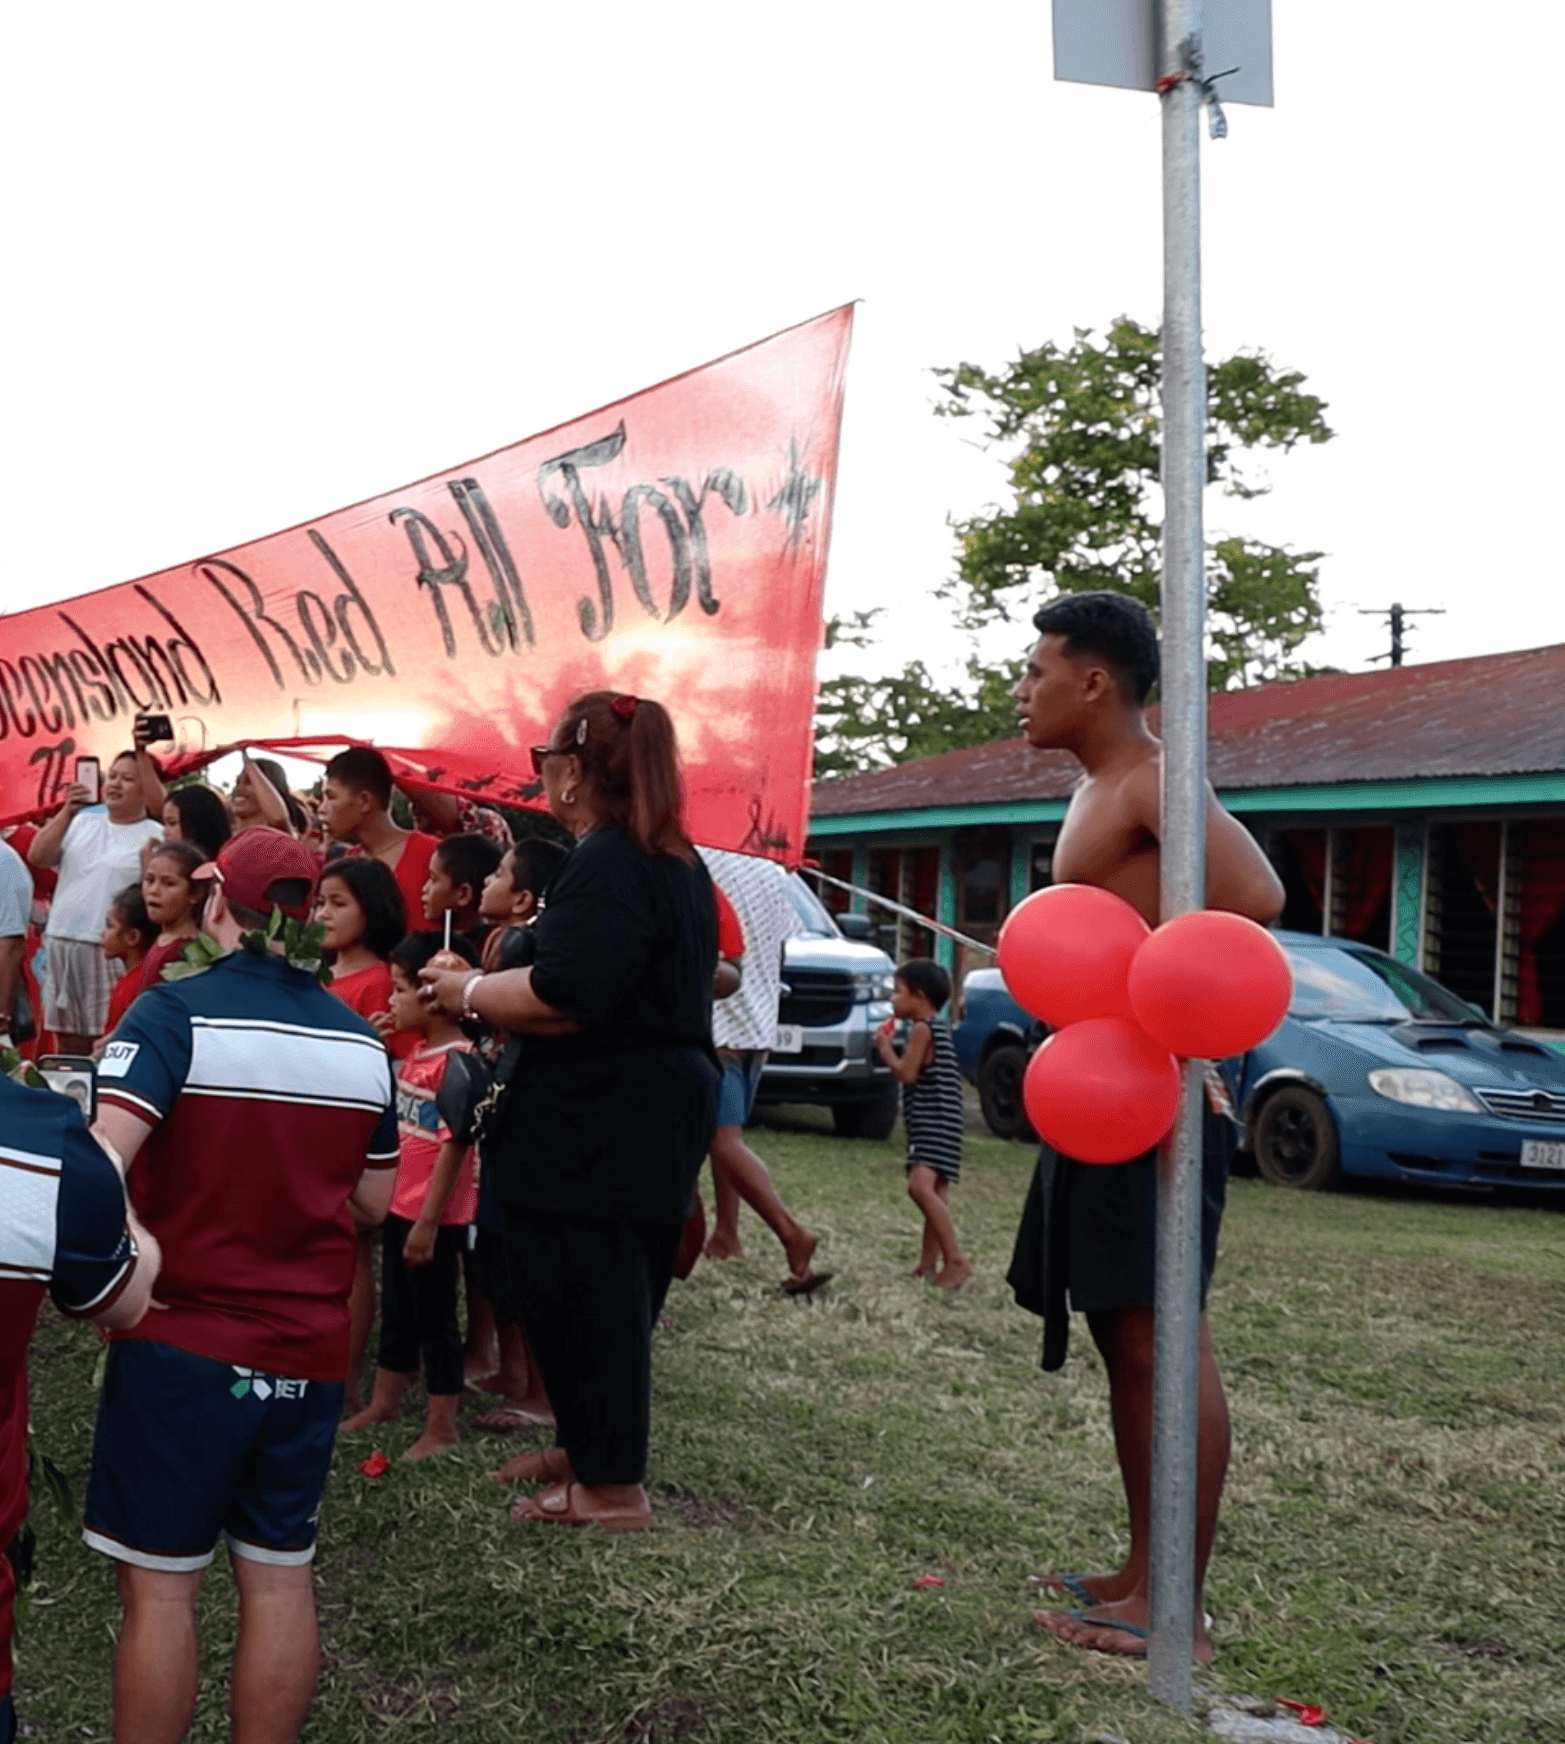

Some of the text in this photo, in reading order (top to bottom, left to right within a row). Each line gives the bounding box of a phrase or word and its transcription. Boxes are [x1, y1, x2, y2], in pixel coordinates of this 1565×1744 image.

[191, 528, 397, 692] Red
[389, 476, 538, 660] All
[537, 418, 749, 644] For
